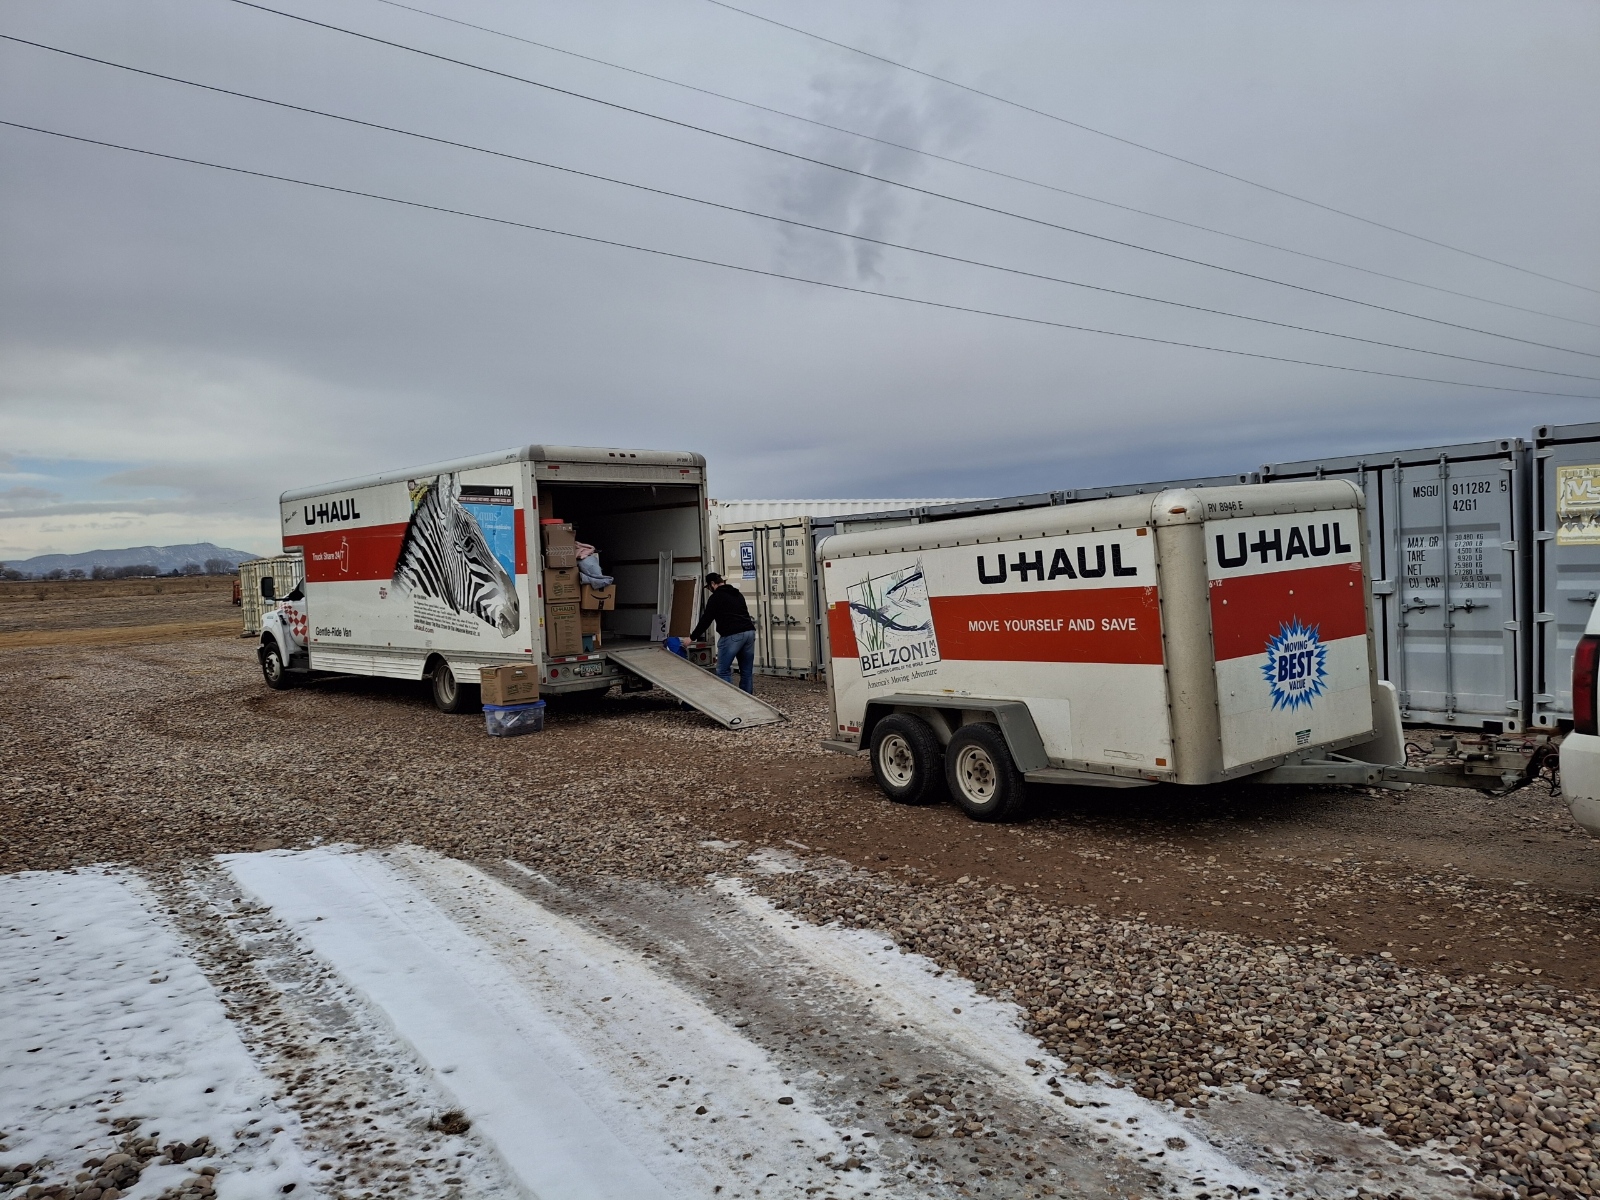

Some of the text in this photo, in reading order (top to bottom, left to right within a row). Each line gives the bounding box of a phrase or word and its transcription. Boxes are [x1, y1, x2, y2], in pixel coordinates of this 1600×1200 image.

[493, 488, 511, 496] IDAHO
[1413, 480, 1508, 498] MSGU 911282 5
[1208, 501, 1244, 512] RV 8946 E
[1452, 499, 1477, 511] 42G1
[1407, 550, 1426, 562] TARE
[1407, 564, 1422, 575] NET
[968, 618, 1137, 632] MOVE YOURSELF AND SAVE
[342, 627, 352, 637] Van
[1284, 640, 1308, 653] MOVING
[861, 642, 929, 671] BELZONI
[1278, 650, 1314, 682] BEST
[868, 669, 938, 690] America's Moving Adventure
[1289, 679, 1306, 691] VALUE
